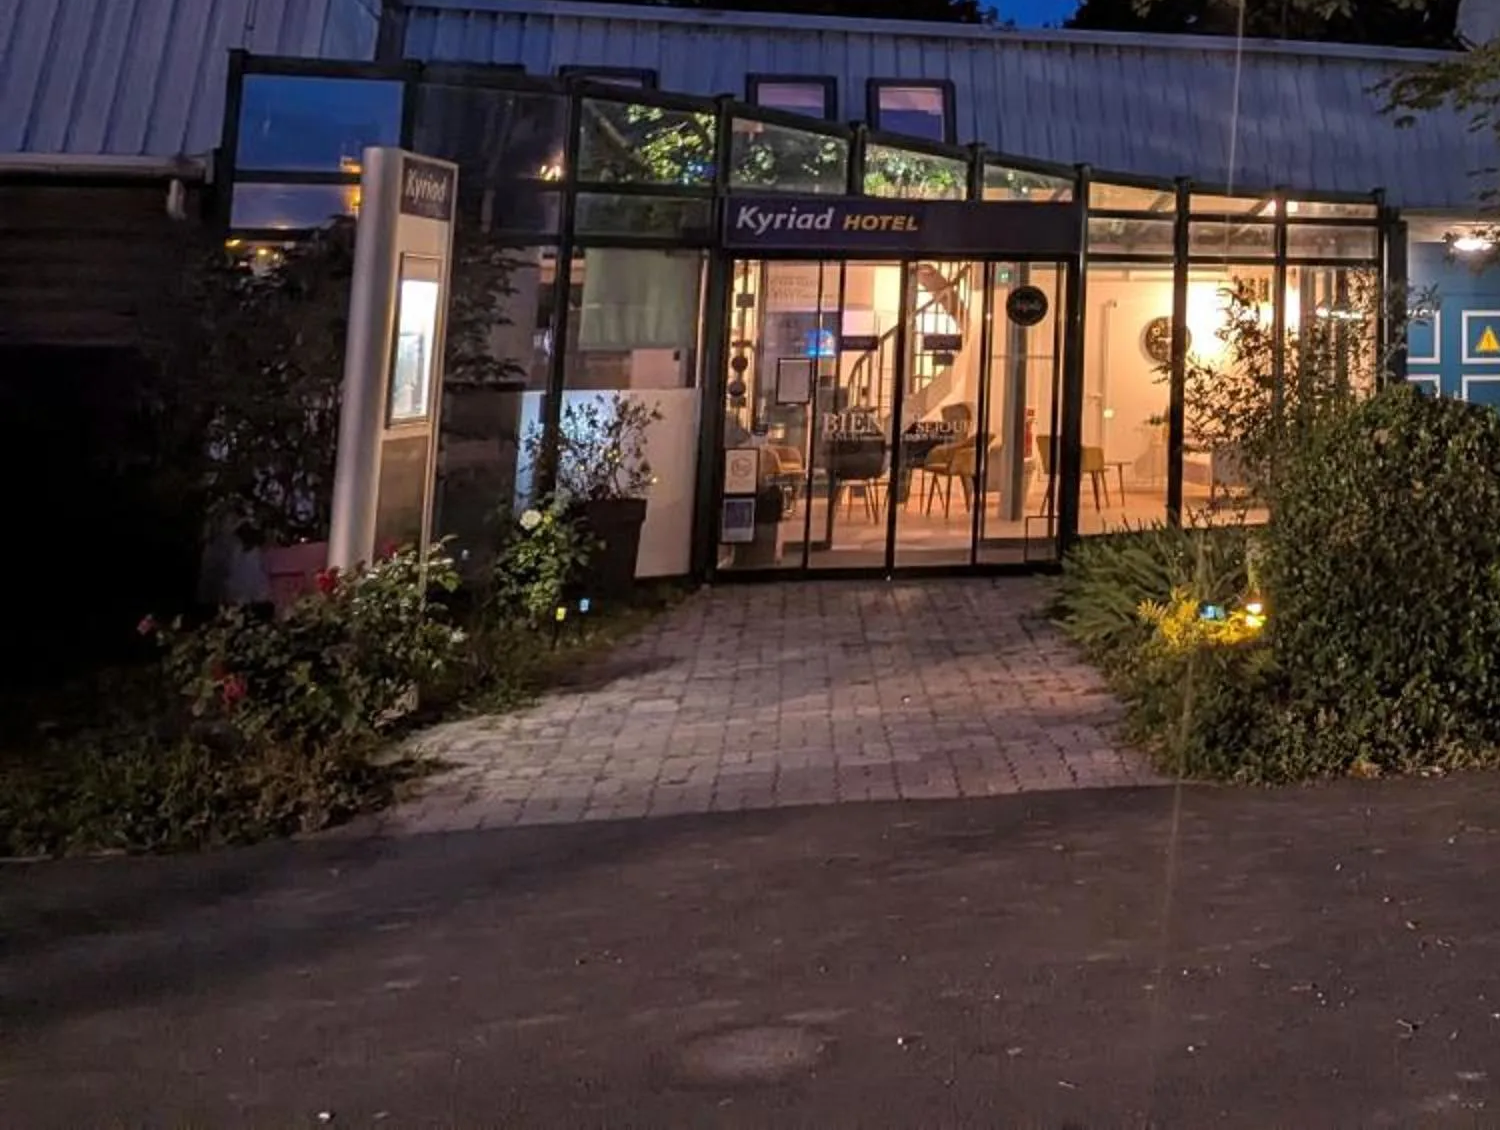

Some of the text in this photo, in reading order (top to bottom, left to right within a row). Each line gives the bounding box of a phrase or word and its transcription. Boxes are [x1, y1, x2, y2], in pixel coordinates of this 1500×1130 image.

[405, 169, 447, 204] Kyriad
[736, 206, 918, 236] Kyriad HOTEL
[822, 413, 886, 433] BIEN
